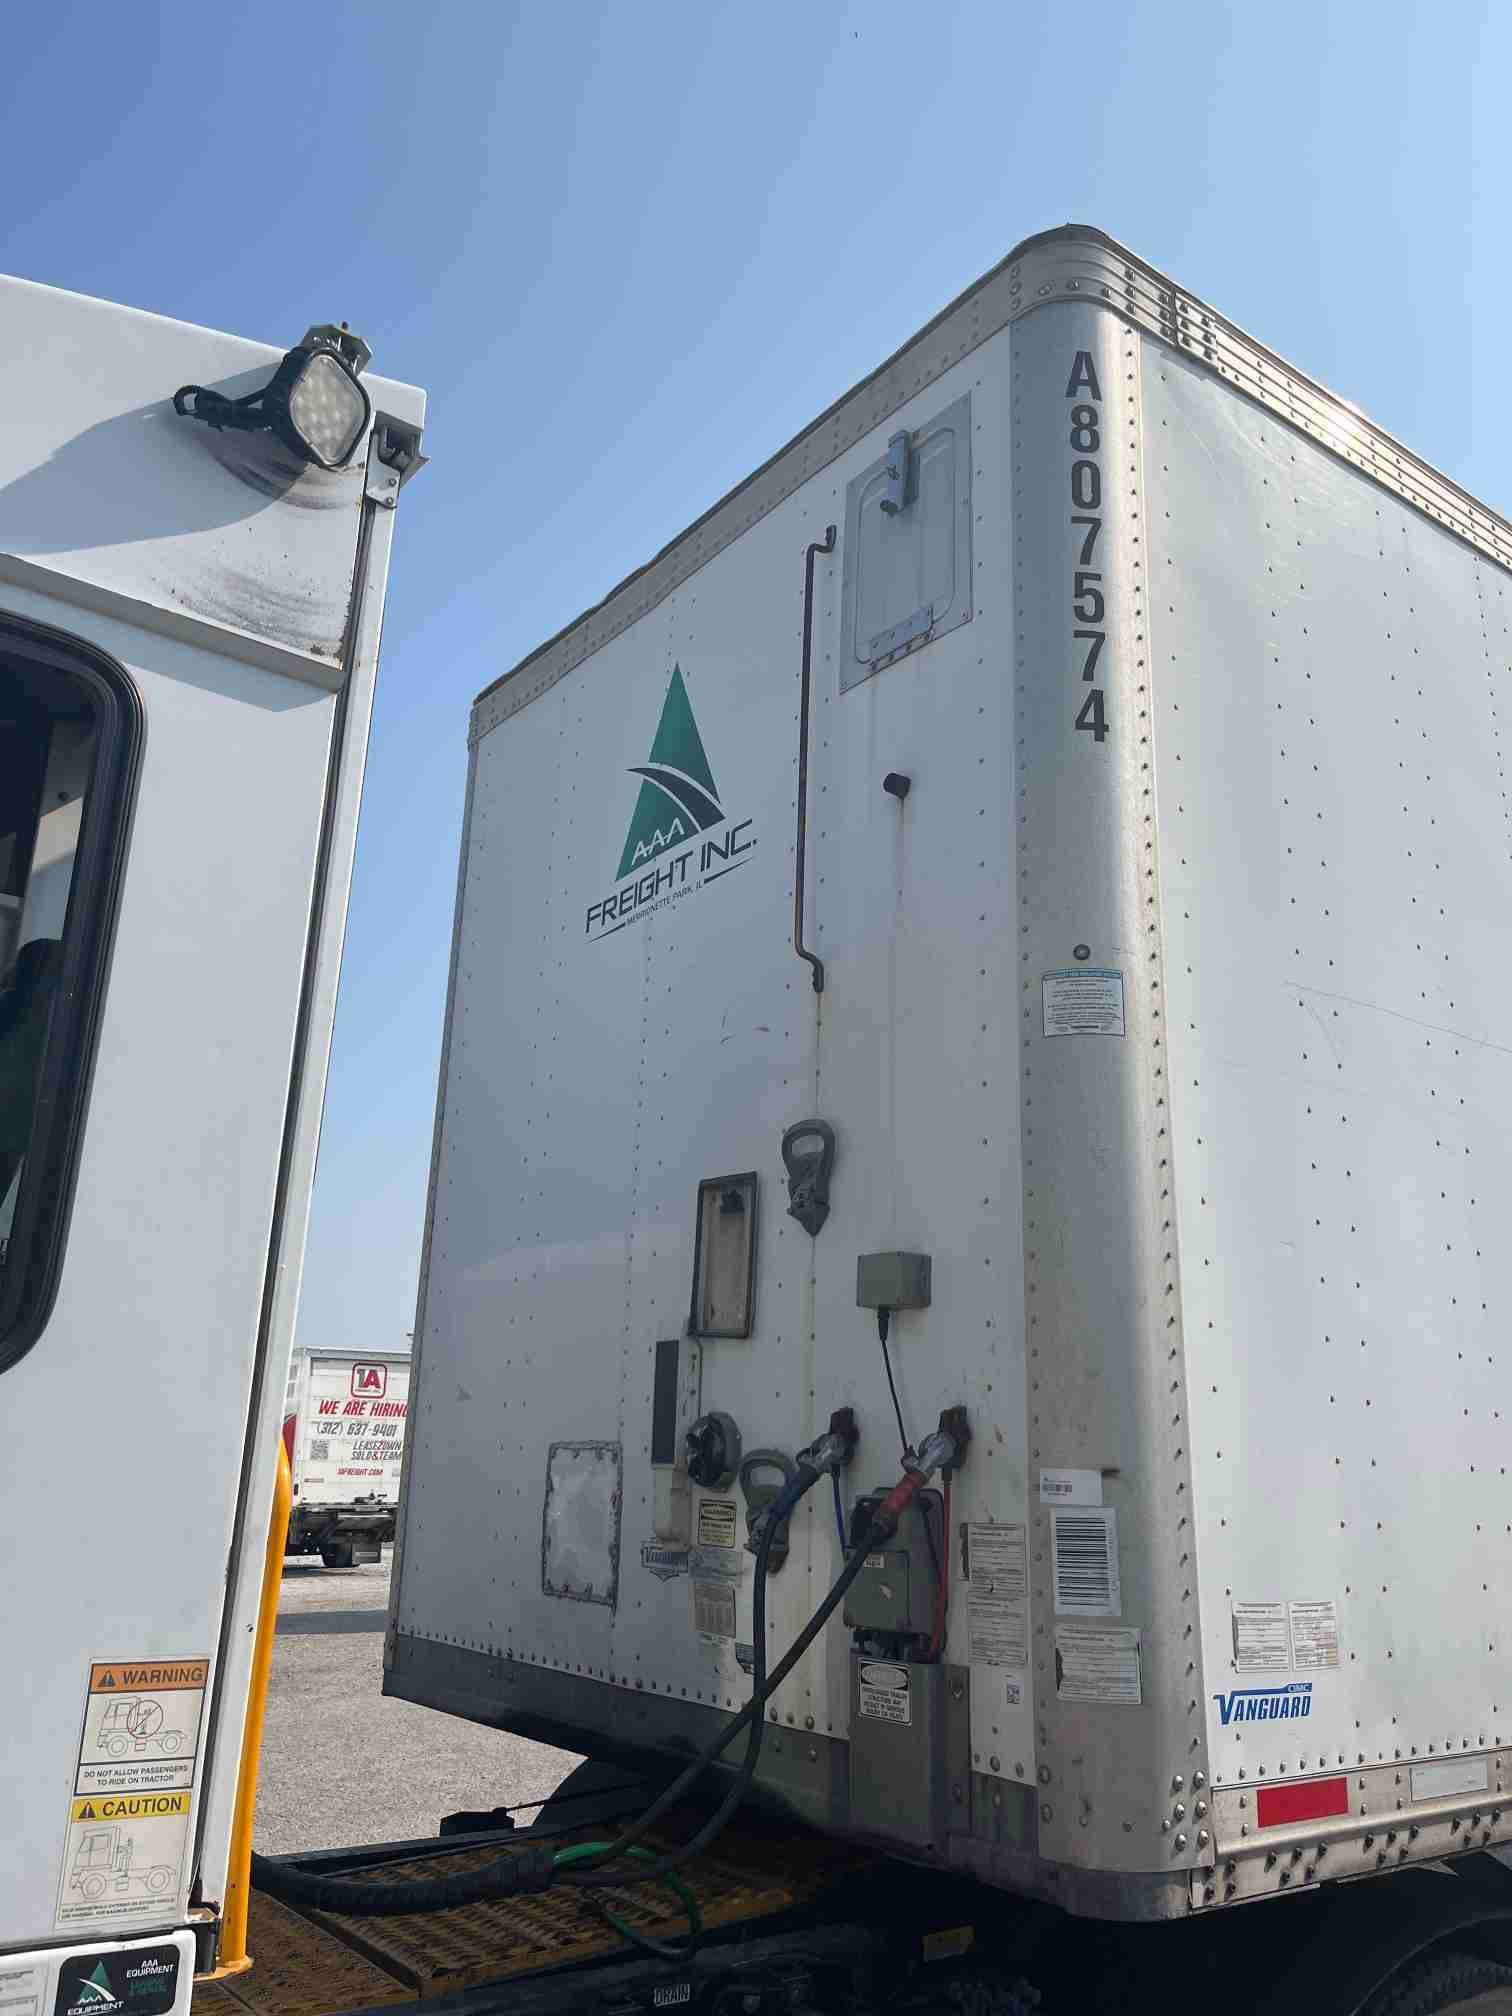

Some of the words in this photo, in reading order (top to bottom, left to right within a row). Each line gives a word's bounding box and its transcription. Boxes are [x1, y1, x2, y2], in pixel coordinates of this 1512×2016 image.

[1064, 350, 1109, 742] A807574
[631, 817, 685, 866] AAA
[585, 849, 694, 933] FREIGHT
[700, 818, 757, 873] INC.
[356, 1368, 381, 1388] 1A
[319, 1400, 339, 1414] WE
[343, 1400, 367, 1416] ARE
[317, 1422, 343, 1435] (312)
[123, 1668, 203, 1686] WARNING
[1215, 1691, 1310, 1725] VANGUARD
[97, 1769, 112, 1777] NOT
[114, 1767, 139, 1776] ALLOW
[141, 1764, 189, 1774] PASSENGERS
[97, 1778, 107, 1786] TO
[109, 1777, 126, 1785] RIDE
[128, 1776, 139, 1784] ON
[141, 1773, 174, 1784] TRACTOR
[103, 1796, 182, 1817] CAUTION
[127, 1965, 174, 1978] EQUIPMENT
[141, 1959, 158, 1968] AAA
[68, 2001, 124, 2015] EQUIPMENT
